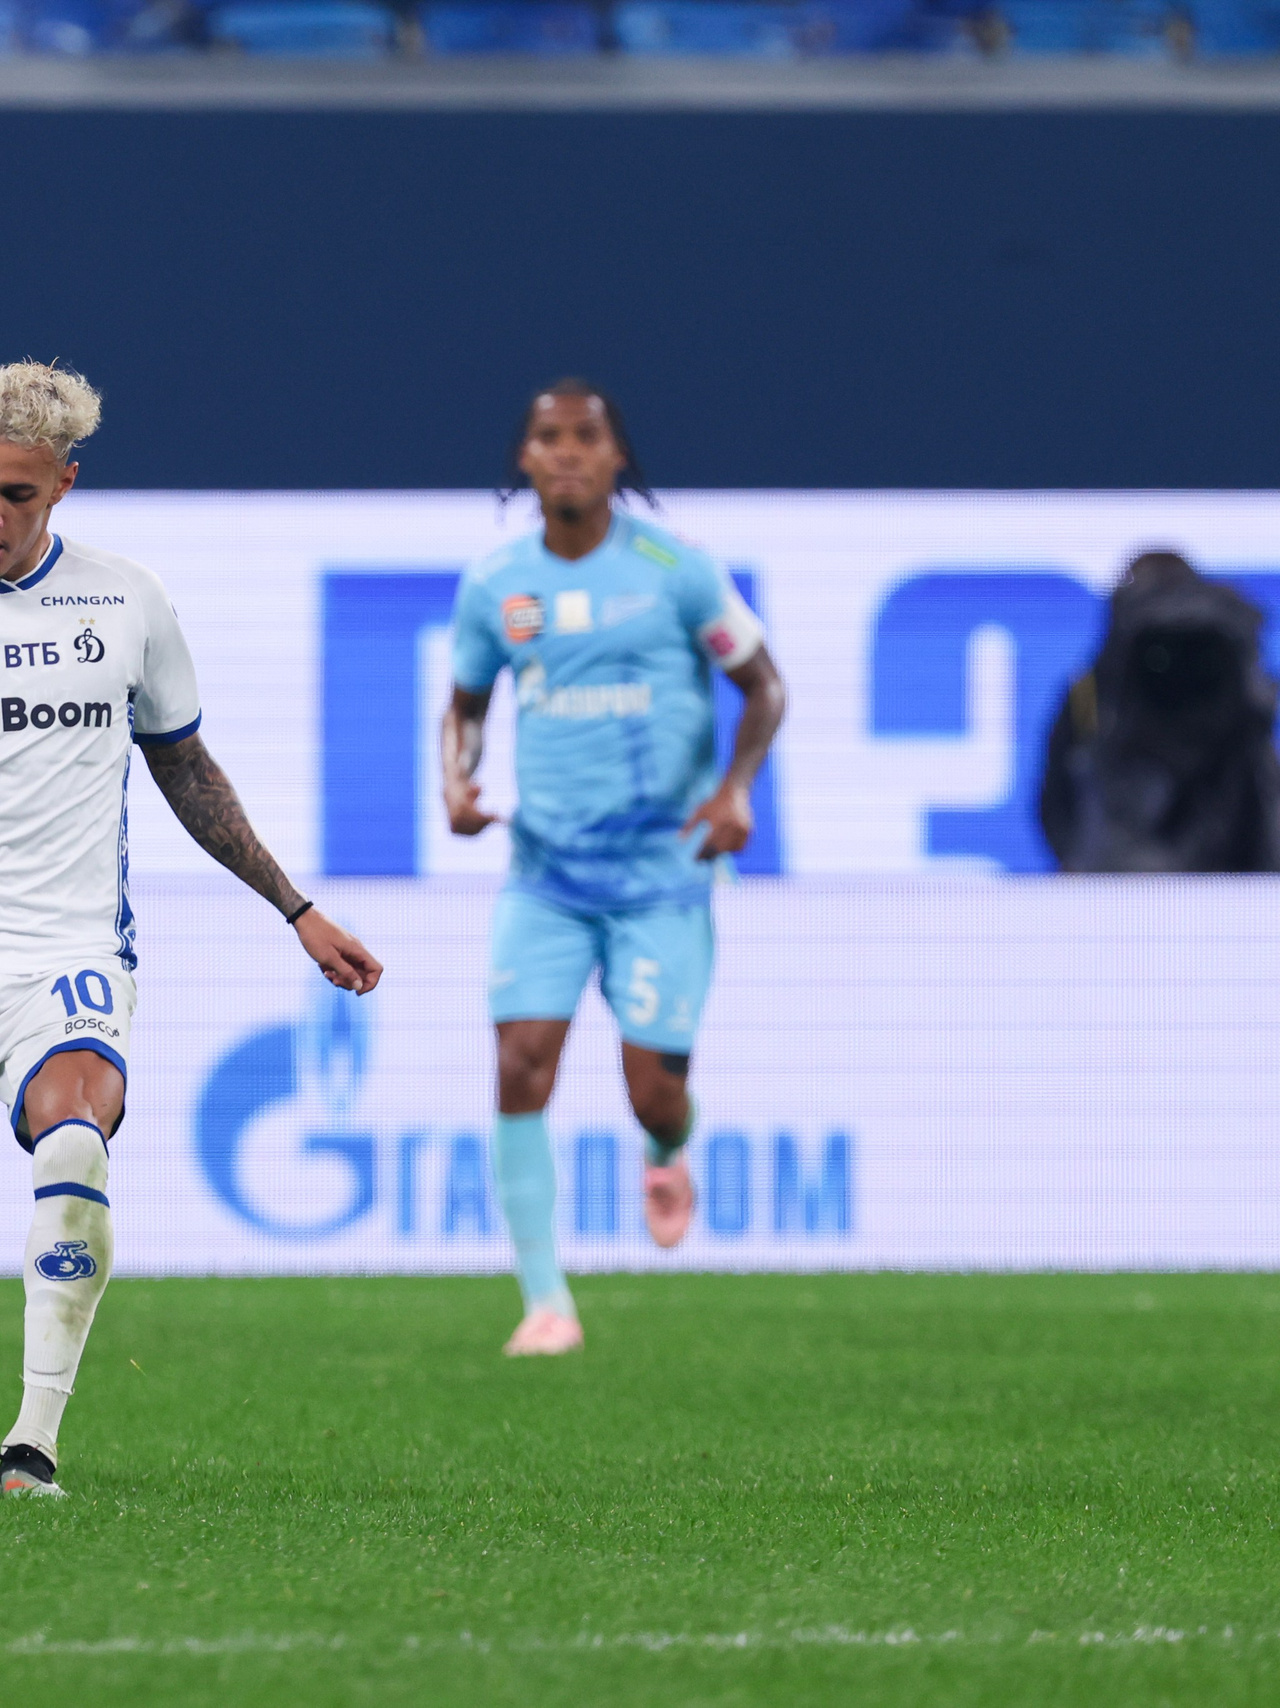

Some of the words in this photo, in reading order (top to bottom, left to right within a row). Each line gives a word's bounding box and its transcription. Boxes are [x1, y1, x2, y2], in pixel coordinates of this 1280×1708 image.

[41, 595, 124, 606] CHANGAN
[4, 641, 60, 668] ВТБ
[50, 969, 113, 1017] 10
[626, 957, 660, 1026] 5
[398, 1132, 851, 1236] ГАПОМ
